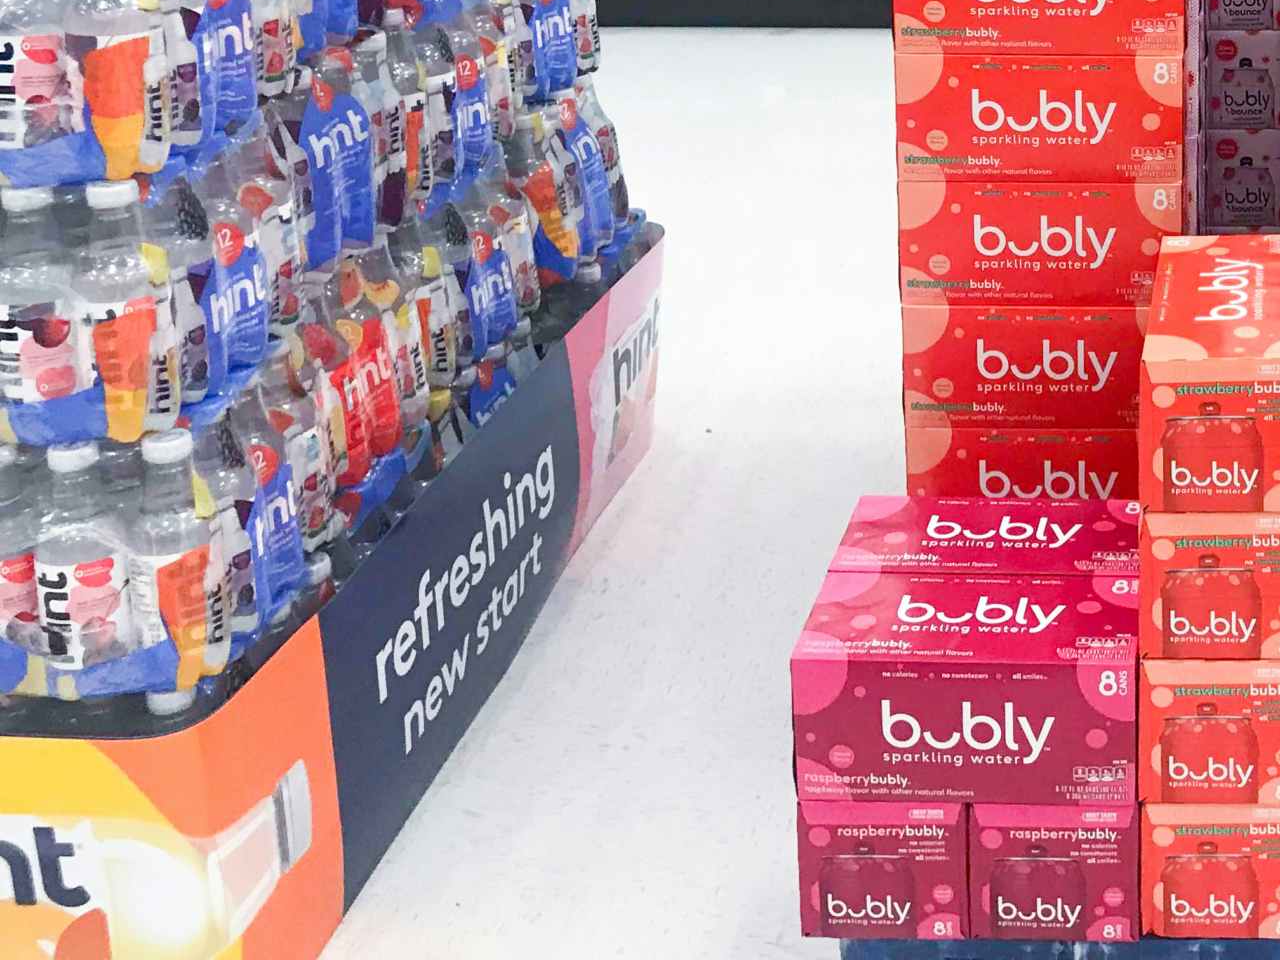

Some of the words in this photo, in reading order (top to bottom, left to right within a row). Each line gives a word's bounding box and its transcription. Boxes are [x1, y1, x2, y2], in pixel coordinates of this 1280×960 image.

[970, 6, 1039, 19] sparkling
[1045, 7, 1088, 17] water
[1153, 63, 1169, 85] 8
[971, 88, 1116, 145] bubly
[972, 135, 1040, 147] sparkling
[1046, 136, 1088, 145] water
[217, 228, 232, 248] 12
[973, 214, 1116, 268] bubly
[1194, 258, 1264, 322] bubly
[976, 339, 1118, 392] bubly
[978, 460, 1119, 500] bubly
[1171, 460, 1260, 494] bubly
[925, 514, 1084, 548] bubly
[374, 444, 554, 704] refreshing
[891, 623, 970, 634] sparkling
[977, 624, 1028, 633] water
[897, 595, 1067, 633] bubly
[1170, 610, 1257, 643] bubly
[403, 635, 469, 755] new
[476, 533, 543, 657] start
[1098, 670, 1118, 696] 8
[1118, 670, 1129, 696] CANS
[880, 699, 1056, 764] bubly
[882, 751, 964, 767] sparkling
[970, 753, 1020, 765] water
[1168, 756, 1255, 788] bubly
[826, 893, 911, 925] bubly
[997, 896, 1082, 928] bubly
[1170, 894, 1257, 924] bubly
